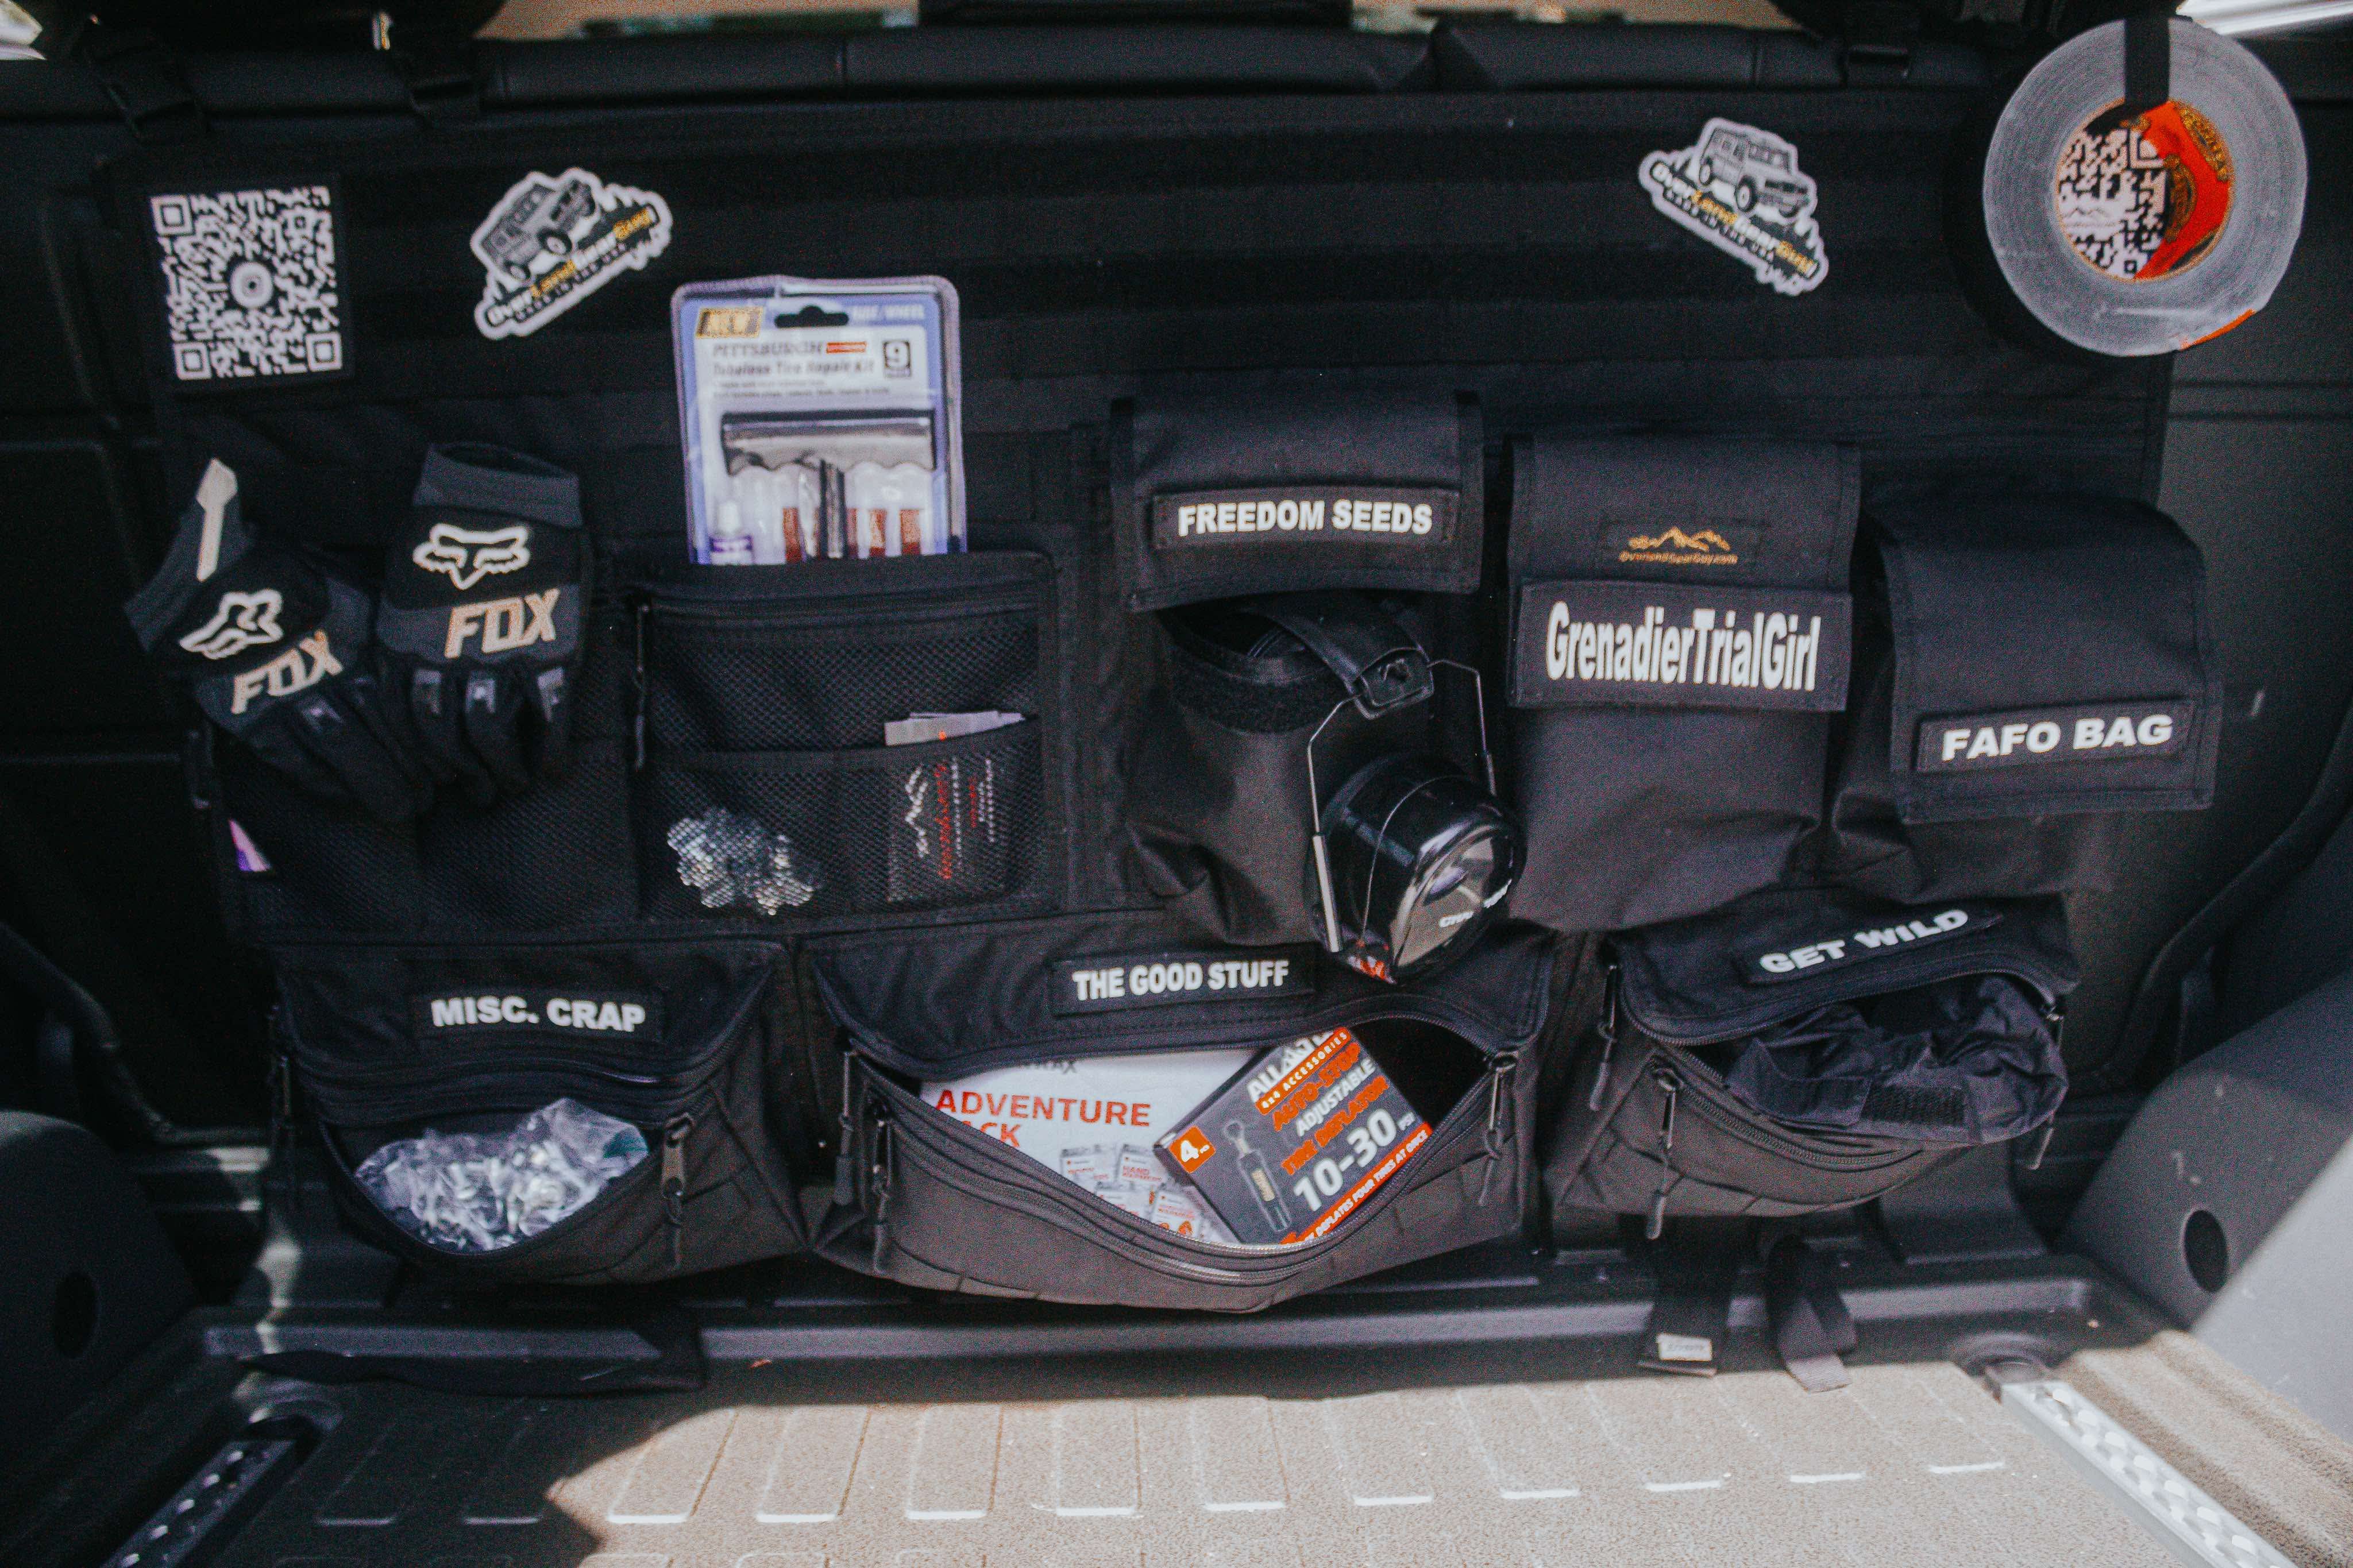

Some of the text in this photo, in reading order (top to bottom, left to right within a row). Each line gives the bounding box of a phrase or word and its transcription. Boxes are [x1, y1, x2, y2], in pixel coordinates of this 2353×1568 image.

[1178, 499, 1433, 536] FREEDOM SEEDS
[444, 588, 560, 658] FOX
[1546, 601, 1821, 691] GrenadierTrialGirl
[231, 630, 343, 715] FOX
[1942, 715, 2173, 762] FAFO BAG
[1760, 909, 1968, 973] GET WILD
[431, 995, 646, 1032] MISC. CRAP
[1072, 960, 1289, 1001] THE GOOD STUFF
[1273, 1042, 1360, 1131] AUTO-STOP
[1283, 1032, 1347, 1090] ACCESSORIES
[935, 1089, 1151, 1126] ADVENTURE
[1281, 1075, 1389, 1175] TIRE DEFLATOR
[1297, 1057, 1376, 1136] ADJUSTABLE
[1182, 1139, 1199, 1162] 4
[1293, 1110, 1396, 1211] 10-30
[1315, 1129, 1428, 1237] DEFLATES FOUR TIRES AT ONCE
